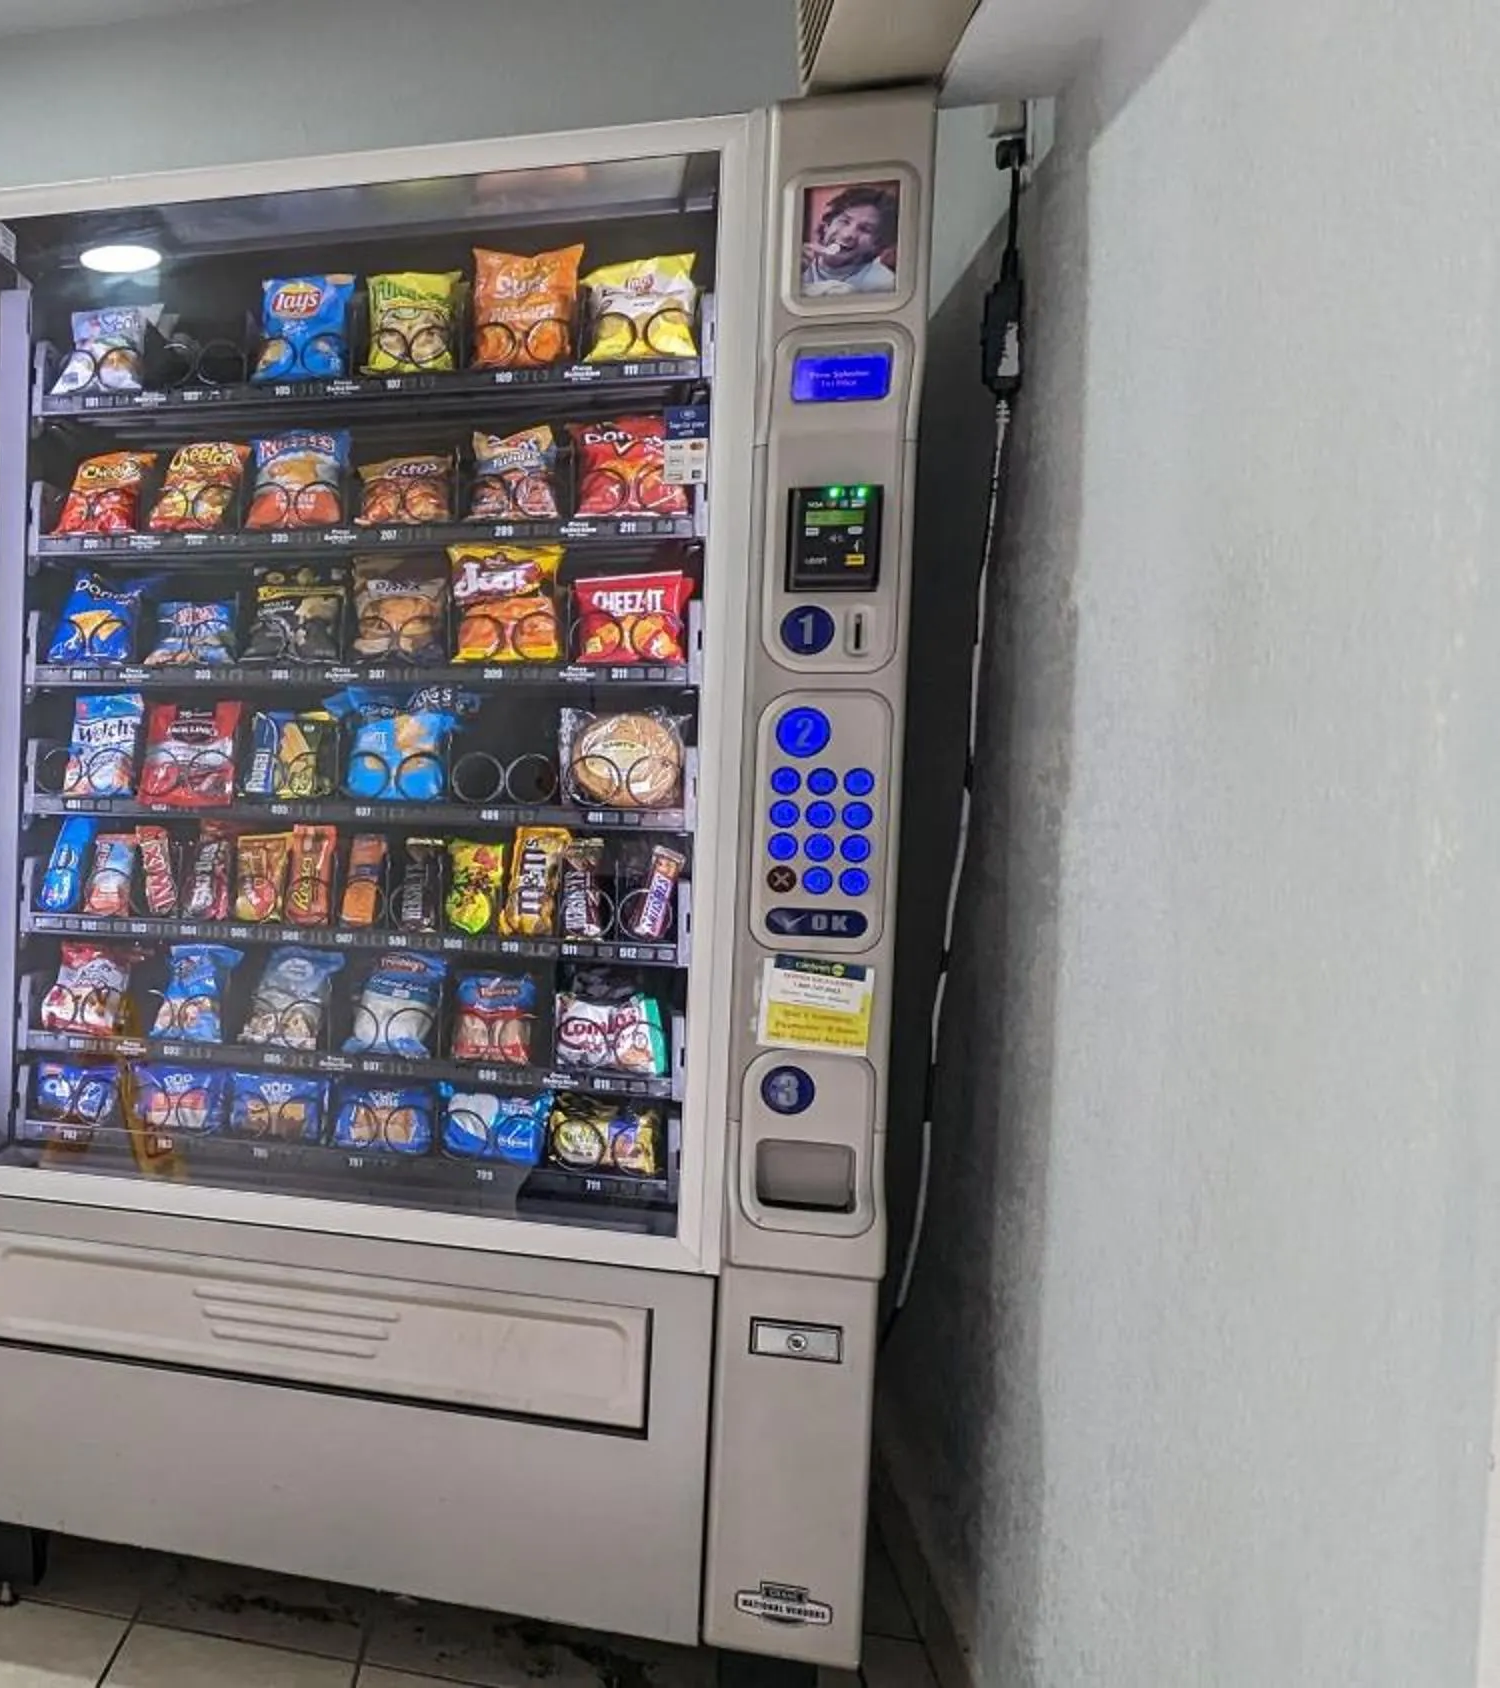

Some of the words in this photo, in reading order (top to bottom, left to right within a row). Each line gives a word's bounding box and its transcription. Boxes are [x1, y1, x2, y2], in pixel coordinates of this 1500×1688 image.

[799, 613, 814, 645] 1
[796, 717, 814, 748] 2
[811, 915, 848, 932] OK
[775, 1072, 800, 1107] 3
